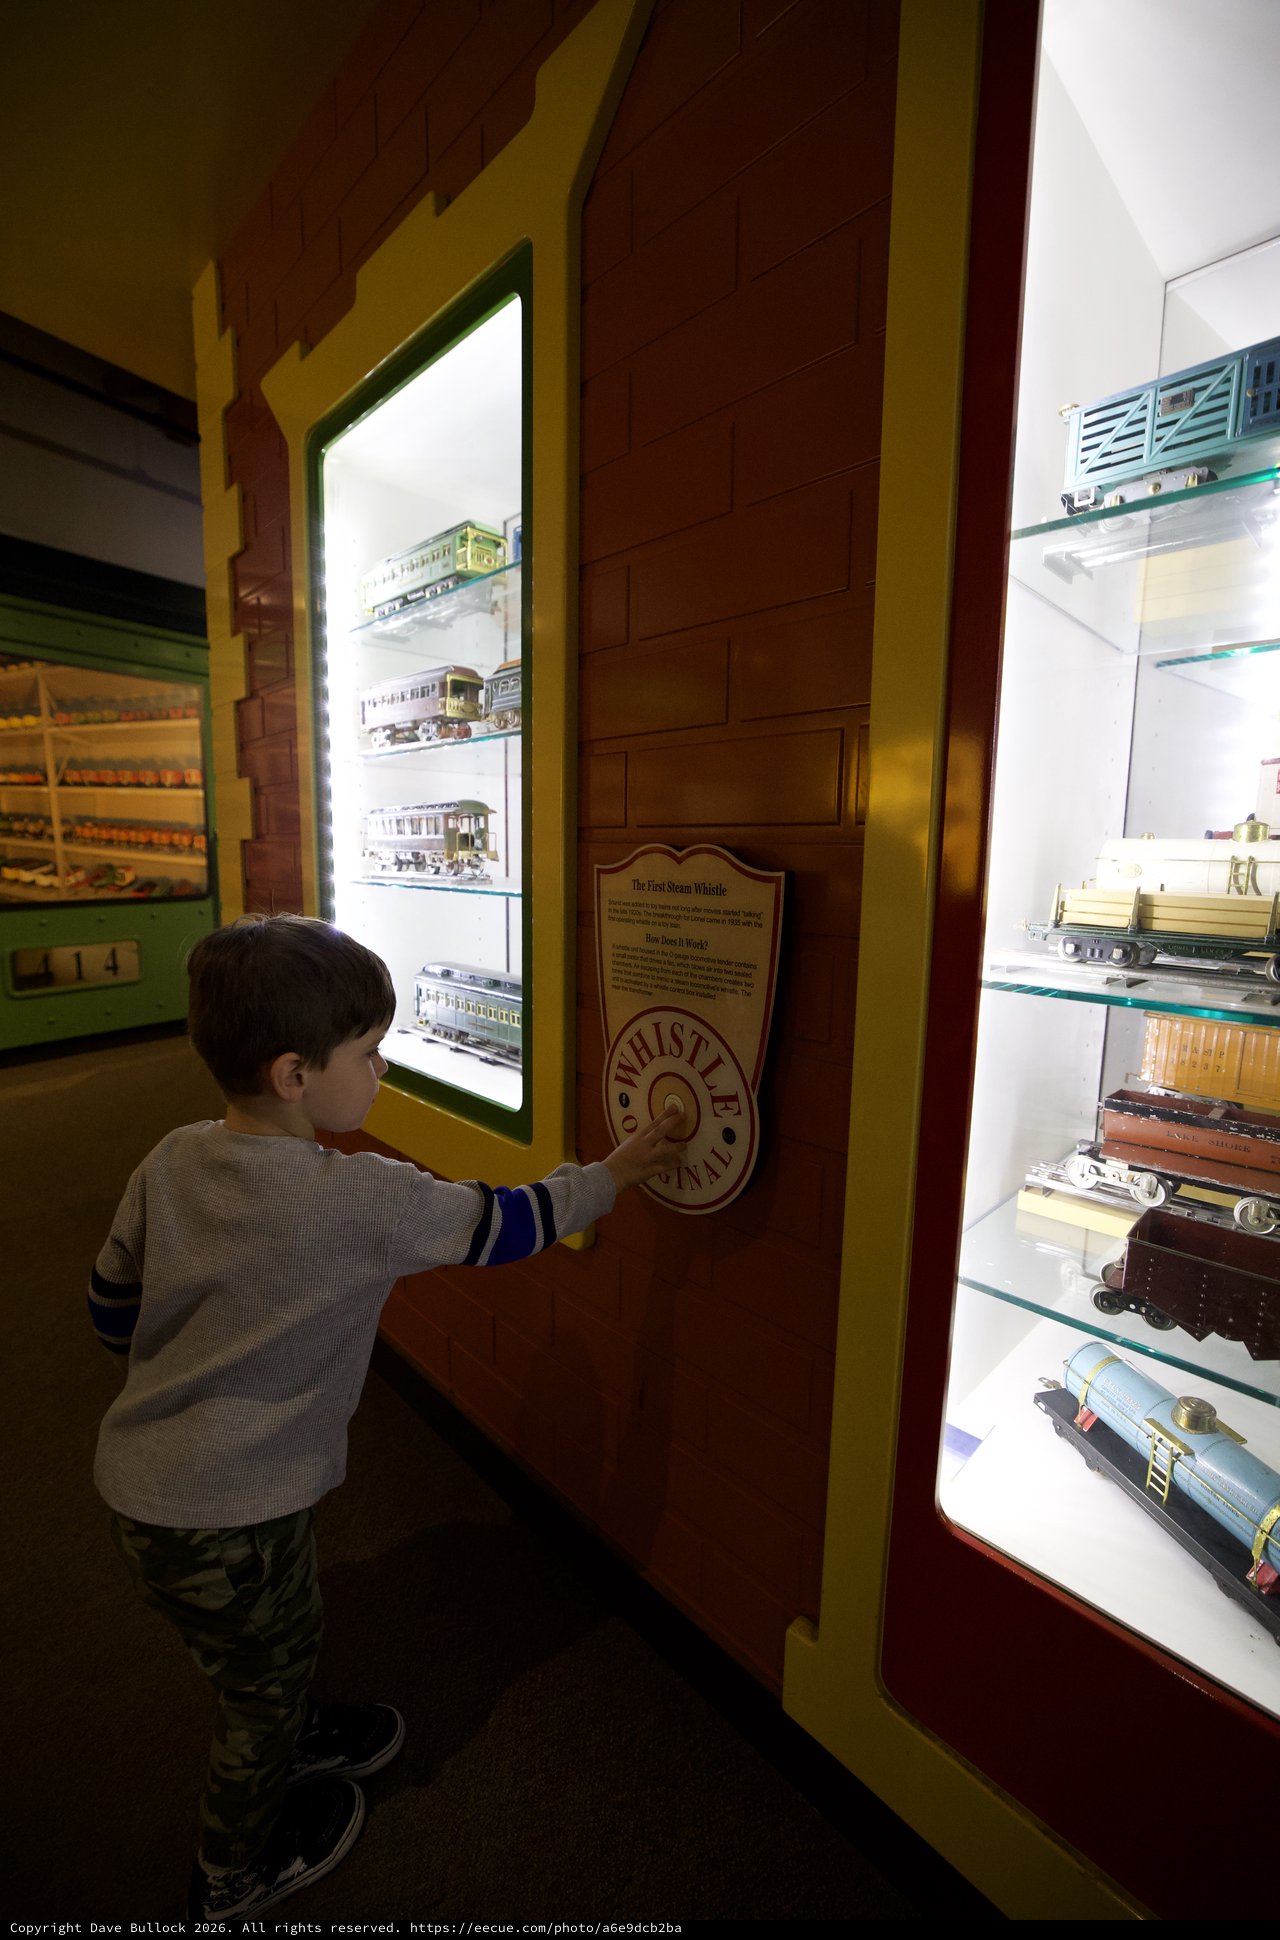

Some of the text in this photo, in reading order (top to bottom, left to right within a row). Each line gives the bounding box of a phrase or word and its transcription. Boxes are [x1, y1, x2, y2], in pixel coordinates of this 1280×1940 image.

[632, 879, 727, 896] The First Steam Whistle
[631, 900, 644, 908] added
[680, 905, 690, 914] long
[616, 917, 635, 925] operating
[653, 911, 683, 921] breakthrough
[646, 933, 708, 950] How Does It Work?
[690, 955, 716, 963] locomotive
[717, 958, 734, 966] tender
[735, 961, 757, 970] contains
[640, 965, 660, 974] escaping
[698, 974, 723, 983] chambers
[724, 978, 743, 987] creates
[744, 981, 755, 989] two
[734, 971, 752, 979] sealed
[624, 978, 643, 986] activated
[669, 986, 685, 994] control
[696, 991, 716, 1000] installed
[632, 971, 650, 979] combine
[690, 980, 720, 992] locomotive's
[740, 989, 752, 997] The
[614, 1021, 742, 1118] WHISTLE
[1167, 1130, 1250, 1152] LAKE SHORE
[622, 1115, 733, 1190] OGINAL
